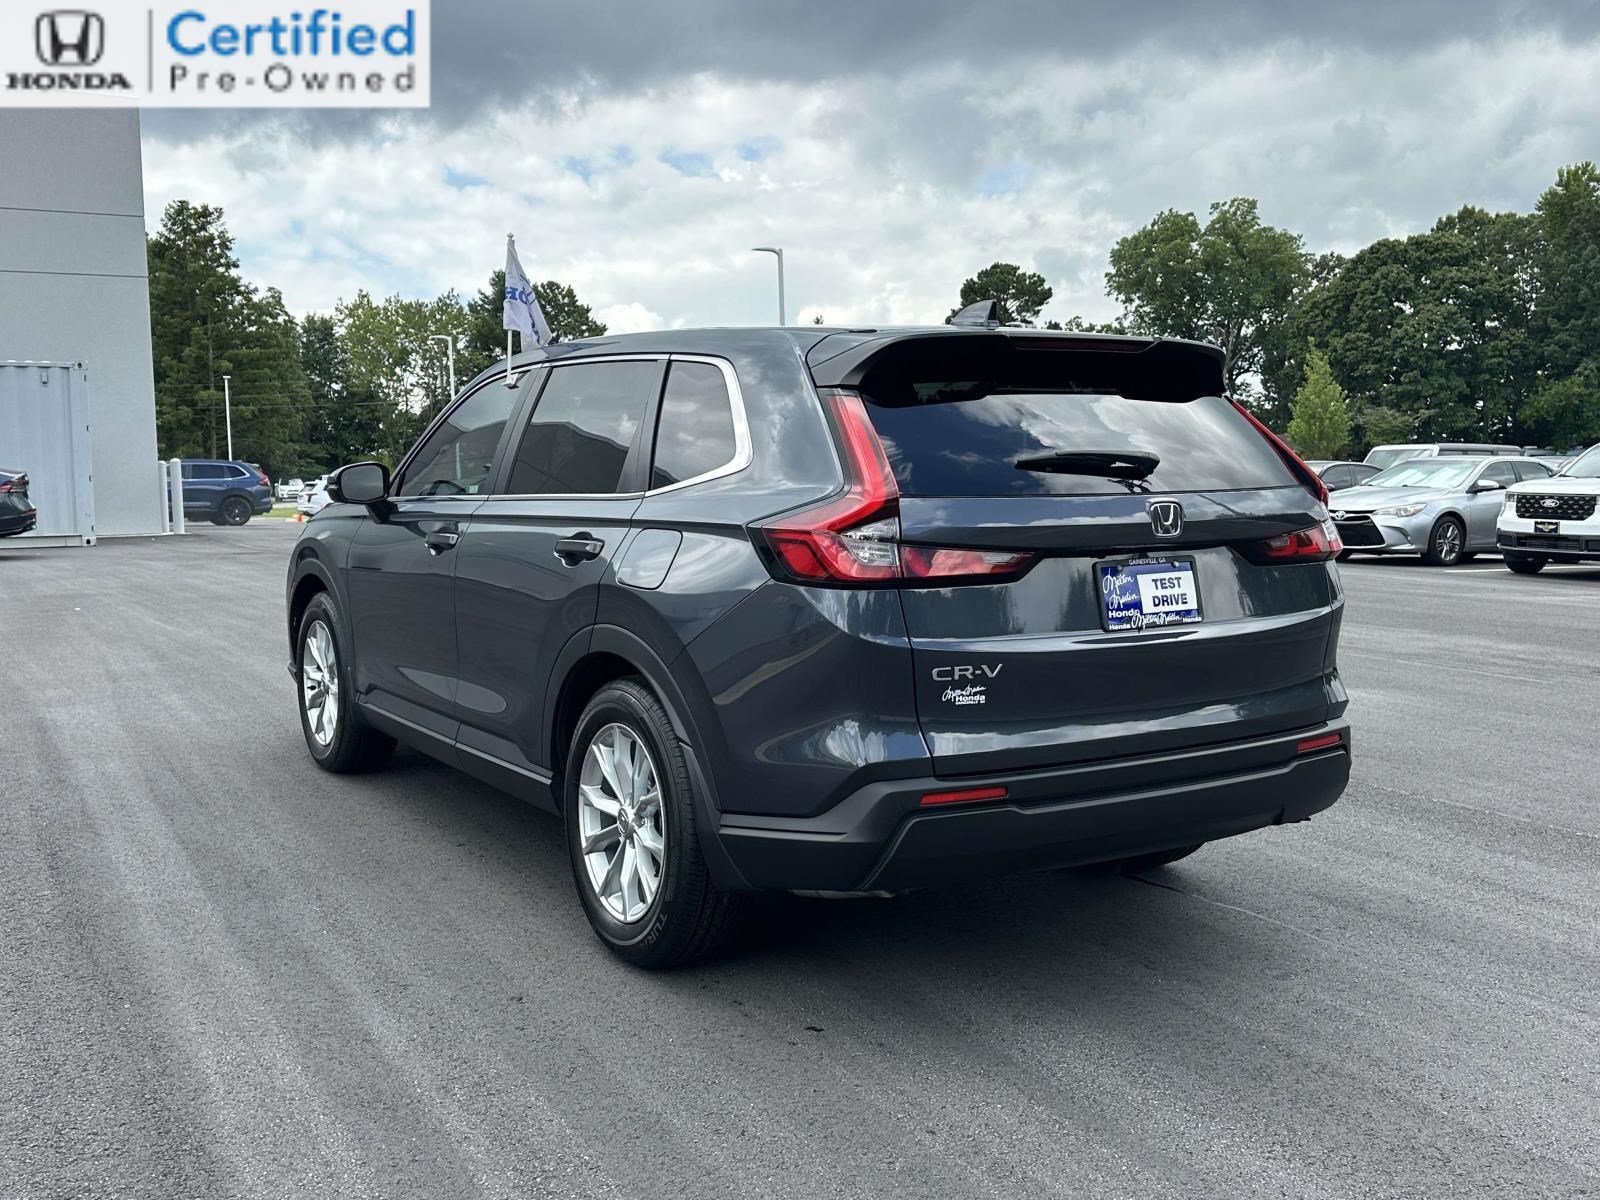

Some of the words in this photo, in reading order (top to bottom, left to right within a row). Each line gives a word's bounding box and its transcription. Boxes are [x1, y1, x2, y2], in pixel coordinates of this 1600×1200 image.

[1152, 577, 1182, 590] TEST
[1152, 593, 1188, 607] DRIVE
[1108, 609, 1141, 618] Honda
[1109, 623, 1131, 631] Honda
[932, 664, 1003, 681] CR-V
[956, 694, 985, 702] Honda
